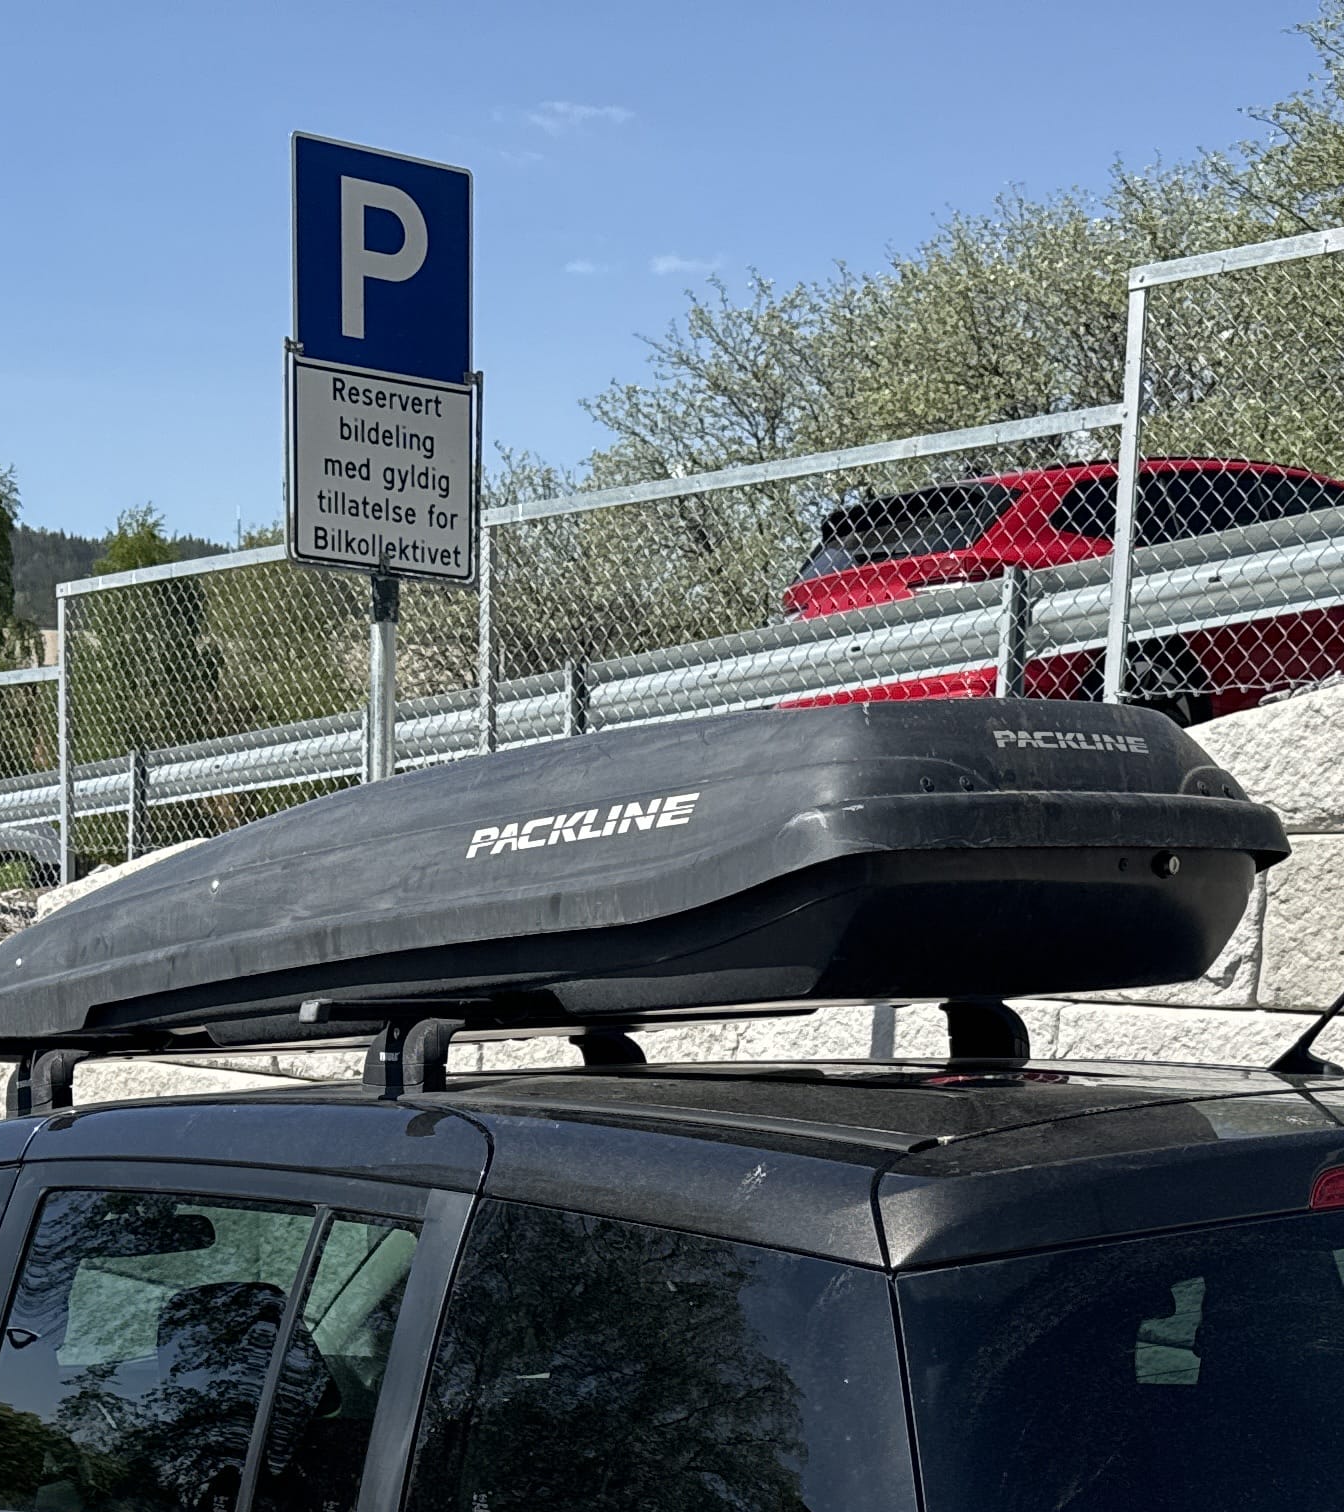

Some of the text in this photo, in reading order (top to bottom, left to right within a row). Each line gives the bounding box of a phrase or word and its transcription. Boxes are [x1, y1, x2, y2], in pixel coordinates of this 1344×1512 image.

[340, 174, 429, 339] P
[332, 376, 443, 418] Reservert
[339, 415, 435, 459] bildeling
[324, 457, 450, 499] med gyldig
[317, 488, 459, 530] tillatelse for
[314, 525, 461, 568] Bilkollektivet
[992, 730, 1149, 754] PACKLINE
[465, 792, 700, 859] PACKLINE
